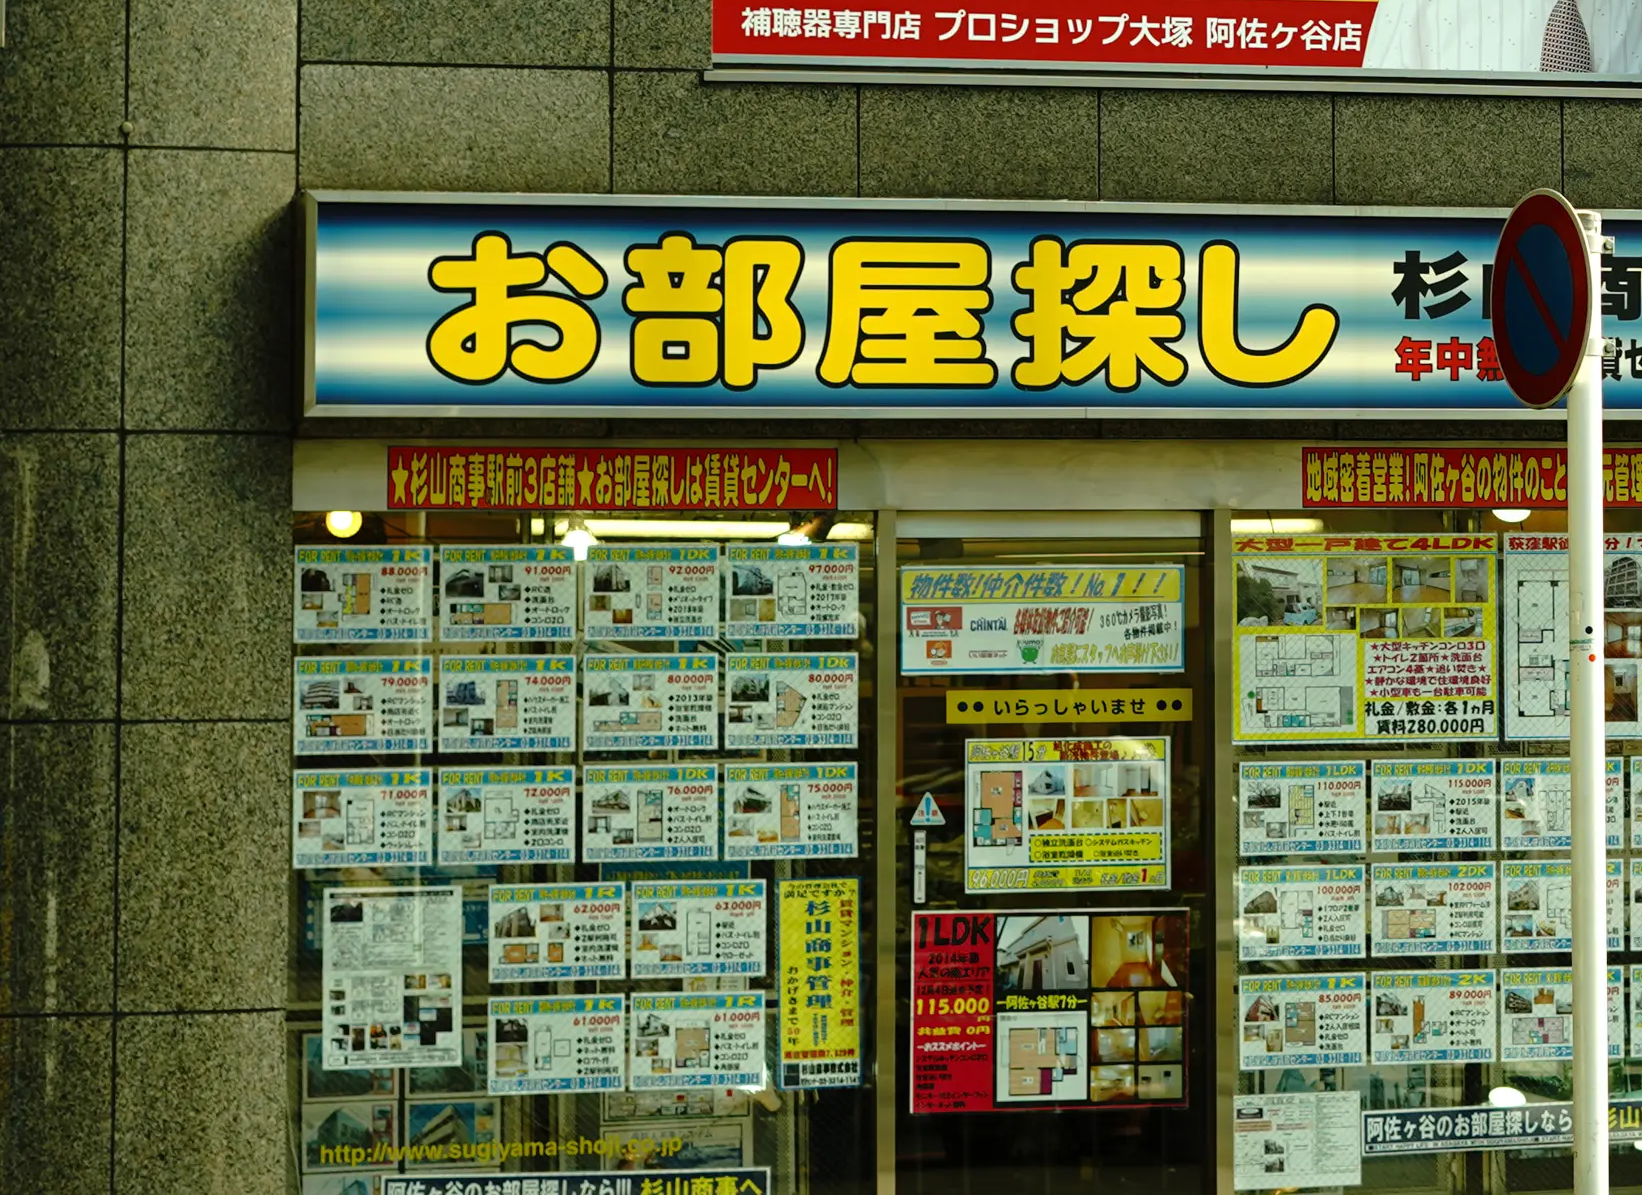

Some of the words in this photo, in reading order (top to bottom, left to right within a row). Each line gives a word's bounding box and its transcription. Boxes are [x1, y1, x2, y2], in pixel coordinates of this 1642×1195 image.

[741, 7, 921, 42] 補聴器専門店
[933, 11, 1192, 50] プロショップ大塚
[1206, 19, 1363, 54] 阿佐ヶ谷店
[426, 229, 1340, 392] お部屋探し
[1235, 538, 1494, 551] 大型一戸建て4LDK
[993, 698, 1146, 715] いらっしゃいませ
[918, 916, 990, 949] 1LDK
[320, 1136, 683, 1167] http://www.sugiyama-shoji.co.jp
